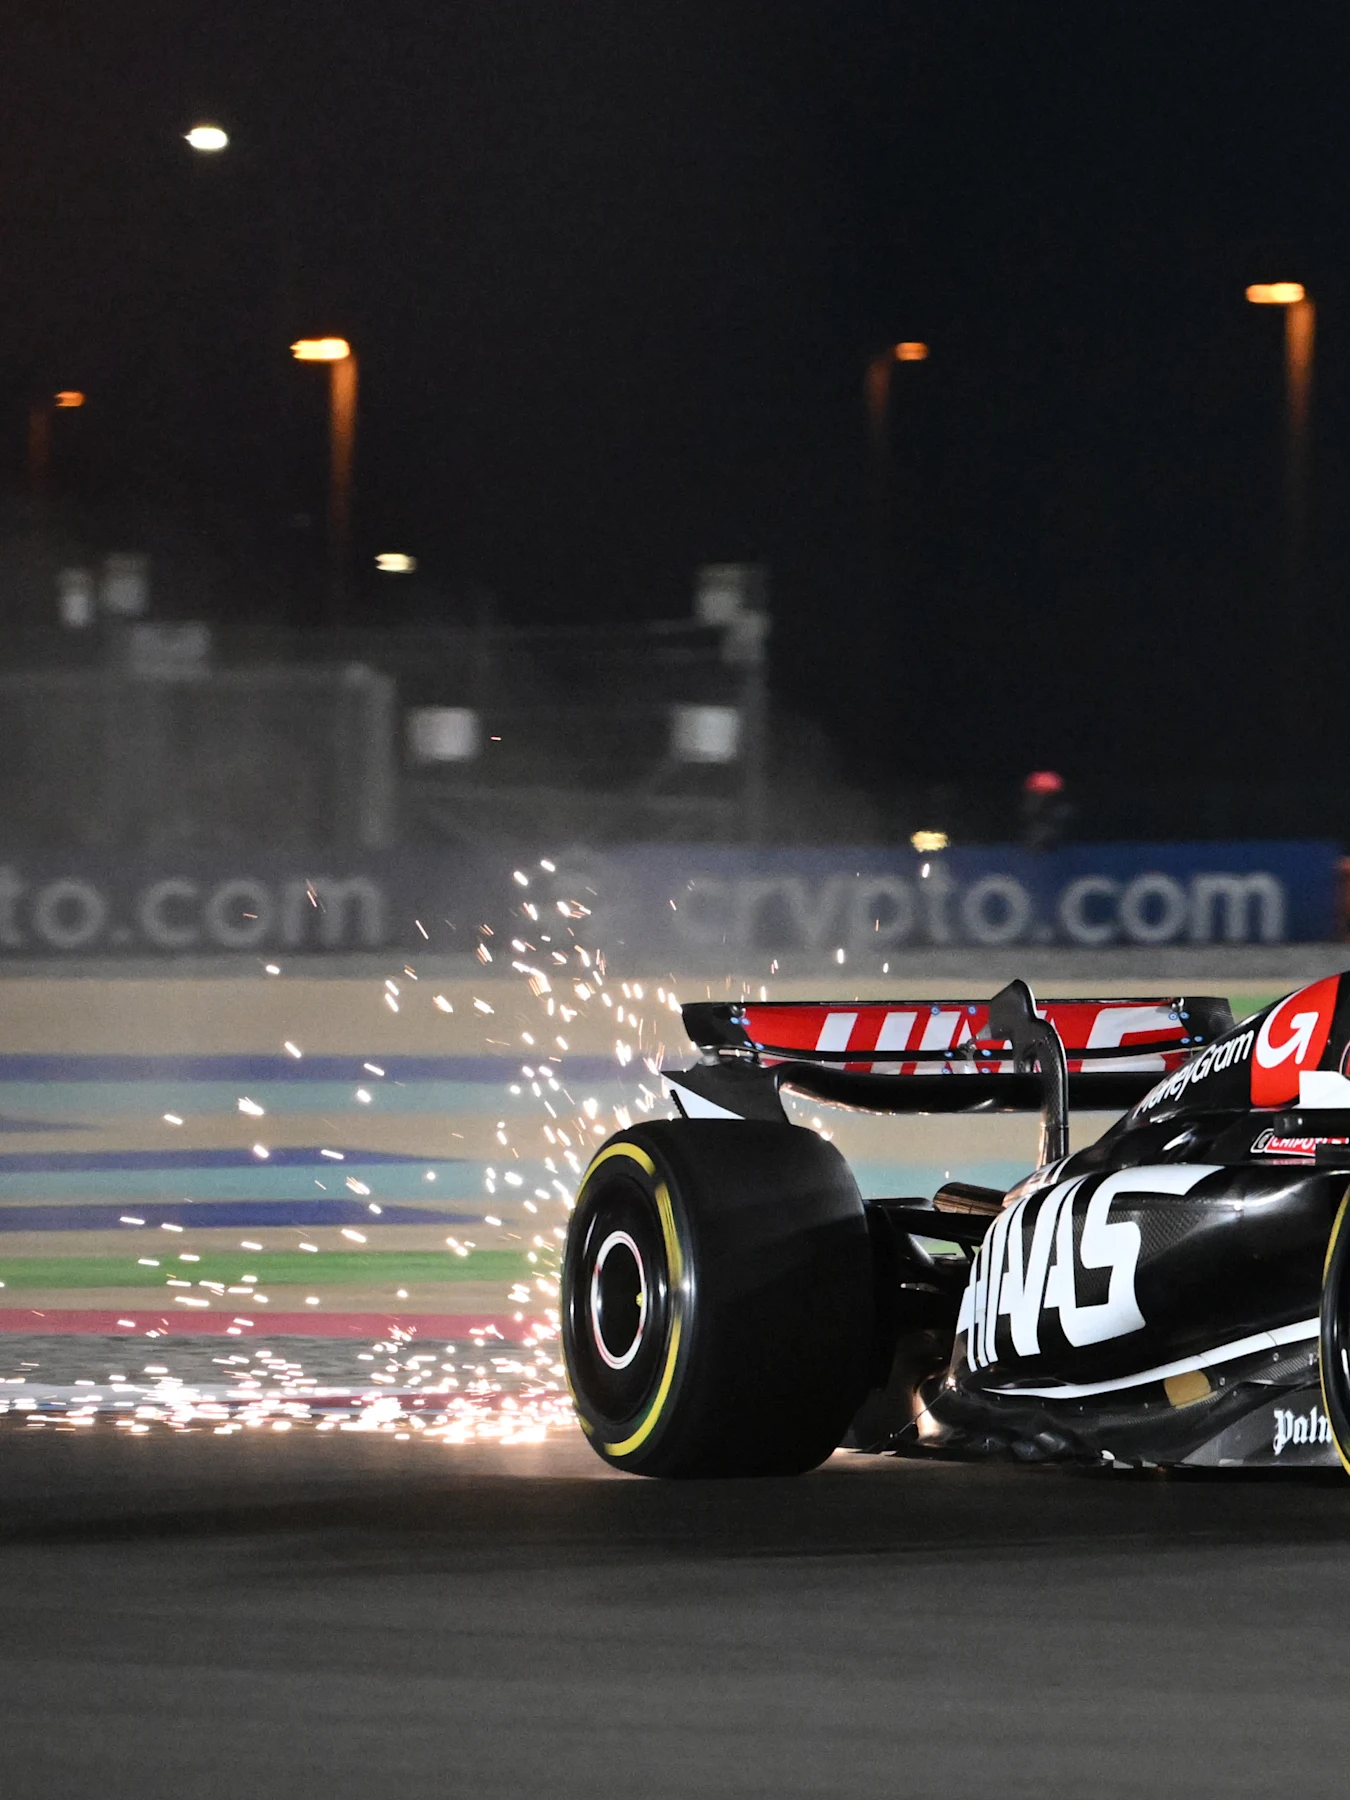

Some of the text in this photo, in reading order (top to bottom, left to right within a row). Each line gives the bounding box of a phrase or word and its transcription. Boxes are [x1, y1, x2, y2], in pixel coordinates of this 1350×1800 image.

[668, 863, 1284, 950] crypto.com
[1131, 1029, 1255, 1121] MoneyGram
[1273, 1405, 1332, 1456] Palm
